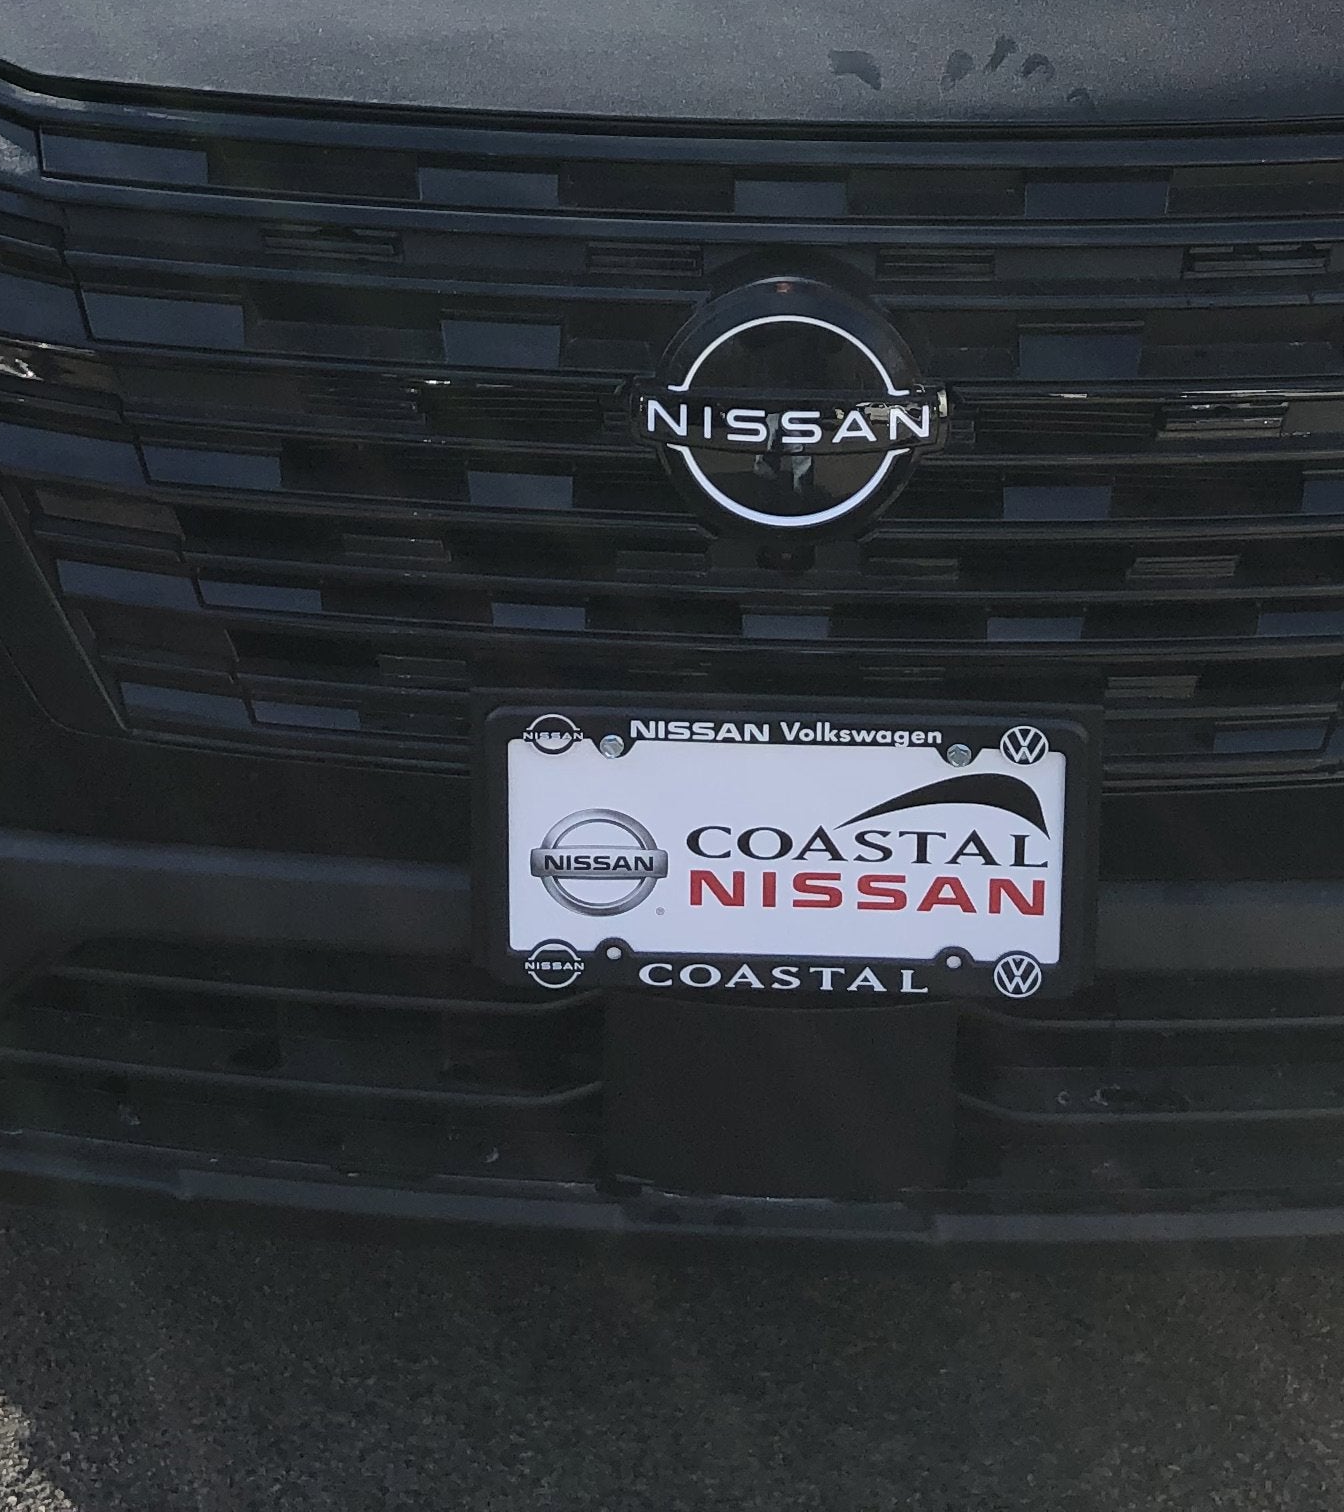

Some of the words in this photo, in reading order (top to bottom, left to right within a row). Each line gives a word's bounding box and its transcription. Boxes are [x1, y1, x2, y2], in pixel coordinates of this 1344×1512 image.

[647, 399, 930, 443] NISSAN
[523, 730, 584, 741] NISSAN
[630, 720, 770, 742] NISSAN
[779, 722, 943, 747] Volkswagen
[686, 825, 1049, 868] COASTAL
[544, 853, 654, 872] NISSAN
[689, 870, 1046, 916] NISSAN
[524, 960, 585, 971] NISSAN
[638, 963, 928, 994] COASTAL
